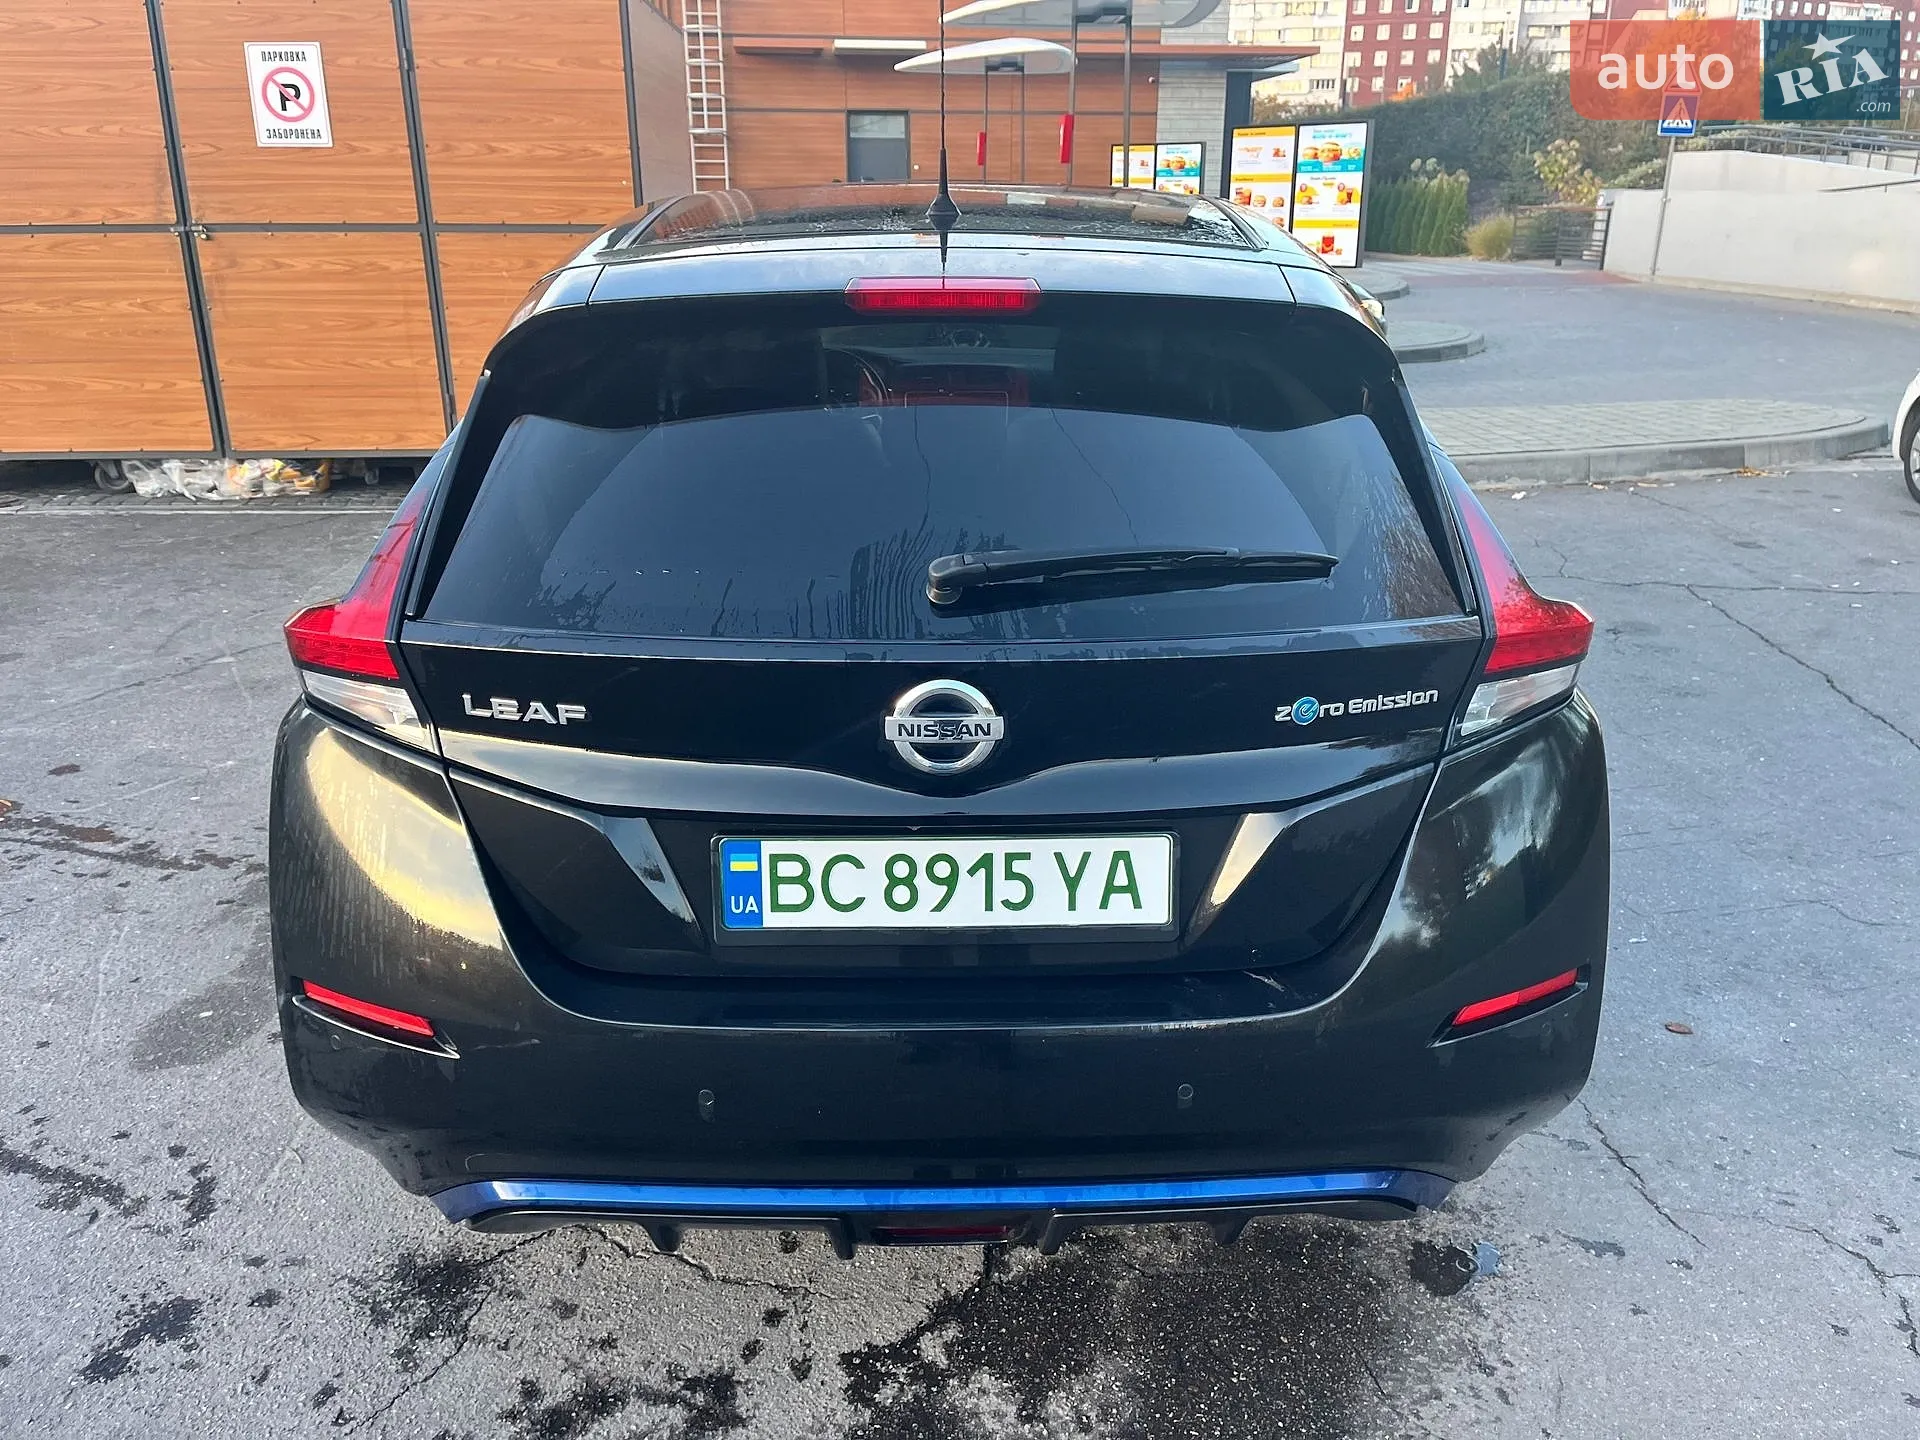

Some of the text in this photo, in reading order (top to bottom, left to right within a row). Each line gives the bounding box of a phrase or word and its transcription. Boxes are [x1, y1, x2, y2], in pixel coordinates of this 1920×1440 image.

[261, 51, 307, 62] ПАРКОВКА
[266, 128, 322, 140] ЗАБОРОНЕНА
[461, 693, 588, 725] LEAF
[1348, 689, 1439, 714] Emission
[896, 721, 993, 739] NISSAN
[768, 850, 1143, 913] BC 8915 YA
[730, 894, 760, 914] UA
